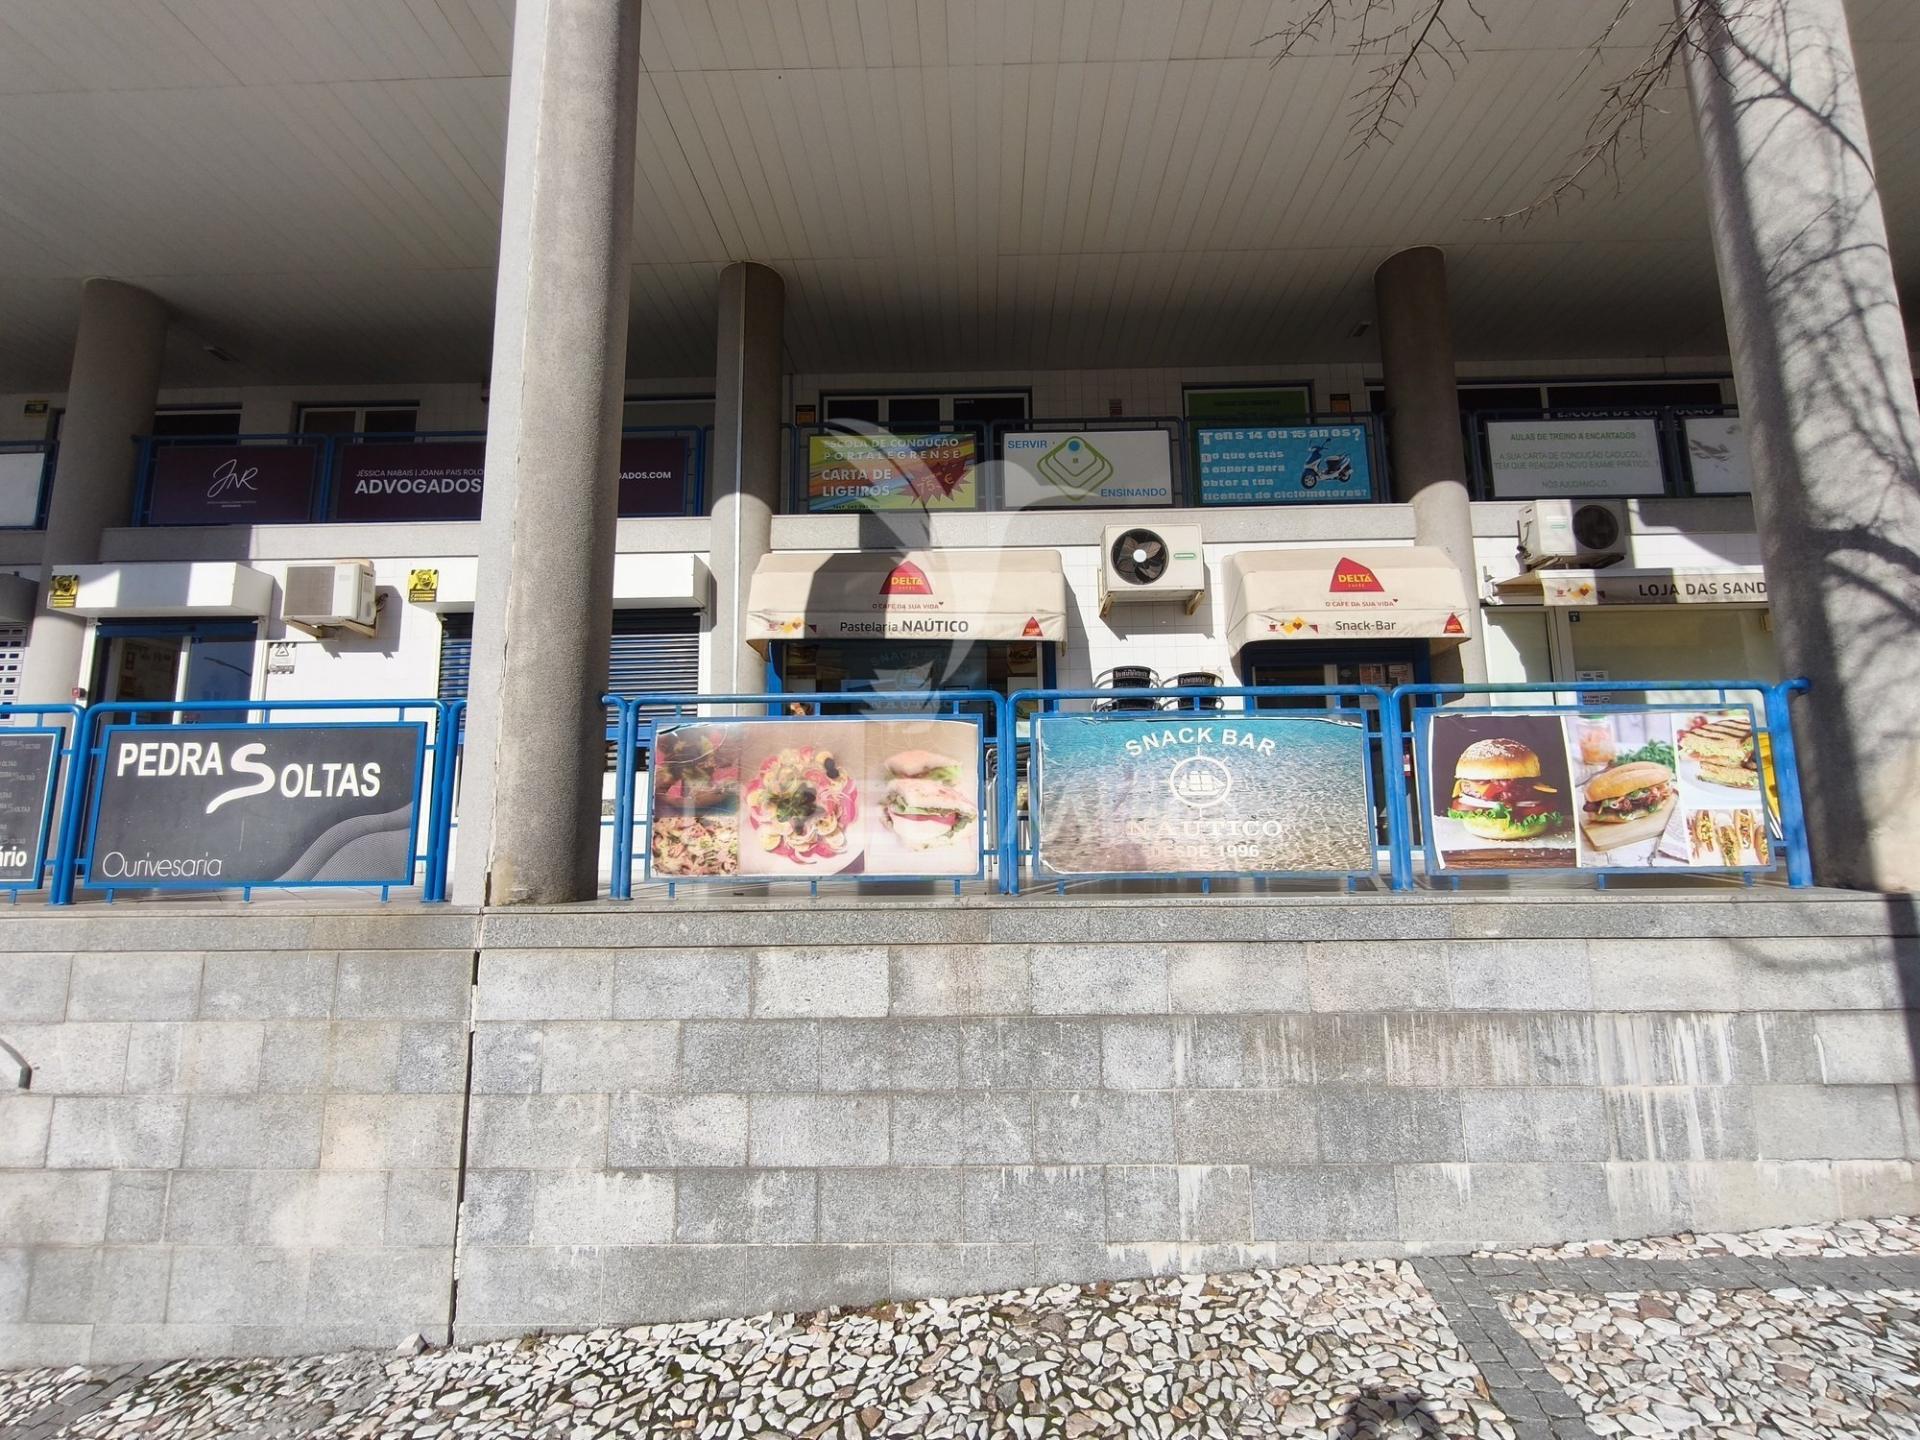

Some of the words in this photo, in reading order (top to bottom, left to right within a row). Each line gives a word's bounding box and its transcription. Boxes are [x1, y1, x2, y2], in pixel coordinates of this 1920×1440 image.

[1200, 431, 1244, 445] Tens
[1247, 431, 1263, 440] 14
[1267, 431, 1288, 439] ou
[1290, 430, 1306, 438] 15
[1309, 428, 1362, 441] anos?
[1511, 431, 1535, 441] AULAS
[1537, 431, 1548, 441] DE
[1550, 431, 1576, 440] TREINO
[1586, 431, 1636, 440] ENCARTADOS
[872, 439, 887, 448] DE
[1007, 439, 1048, 449] SERVIR
[824, 450, 960, 460] PORTALEGRENSE
[1222, 452, 1245, 461] que
[418, 468, 443, 477] JOANA
[446, 468, 461, 476] PAIS
[822, 469, 868, 480] CARTA
[873, 469, 891, 479] DE
[1212, 465, 1255, 474] espera
[1257, 464, 1285, 473] para
[354, 478, 482, 494] ADVOGADOS
[1202, 478, 1238, 487] obter
[1252, 478, 1274, 486] tua
[822, 485, 890, 496] LIGEIROS
[1100, 487, 1167, 497] ENSINANDO
[1255, 490, 1272, 499] de
[1639, 583, 1680, 597] LOJA
[1686, 582, 1717, 595] DAS
[840, 620, 898, 633] Pastelaria
[902, 617, 969, 633] NAÚTICO
[1335, 620, 1396, 631] Snack-Bar
[1125, 727, 1213, 757] SNACK
[1222, 728, 1276, 757] BAR
[117, 742, 223, 777] PEDRA
[1151, 844, 1210, 858] DESDE
[1218, 844, 1260, 858] 1996
[102, 851, 223, 878] Ourivesaria
